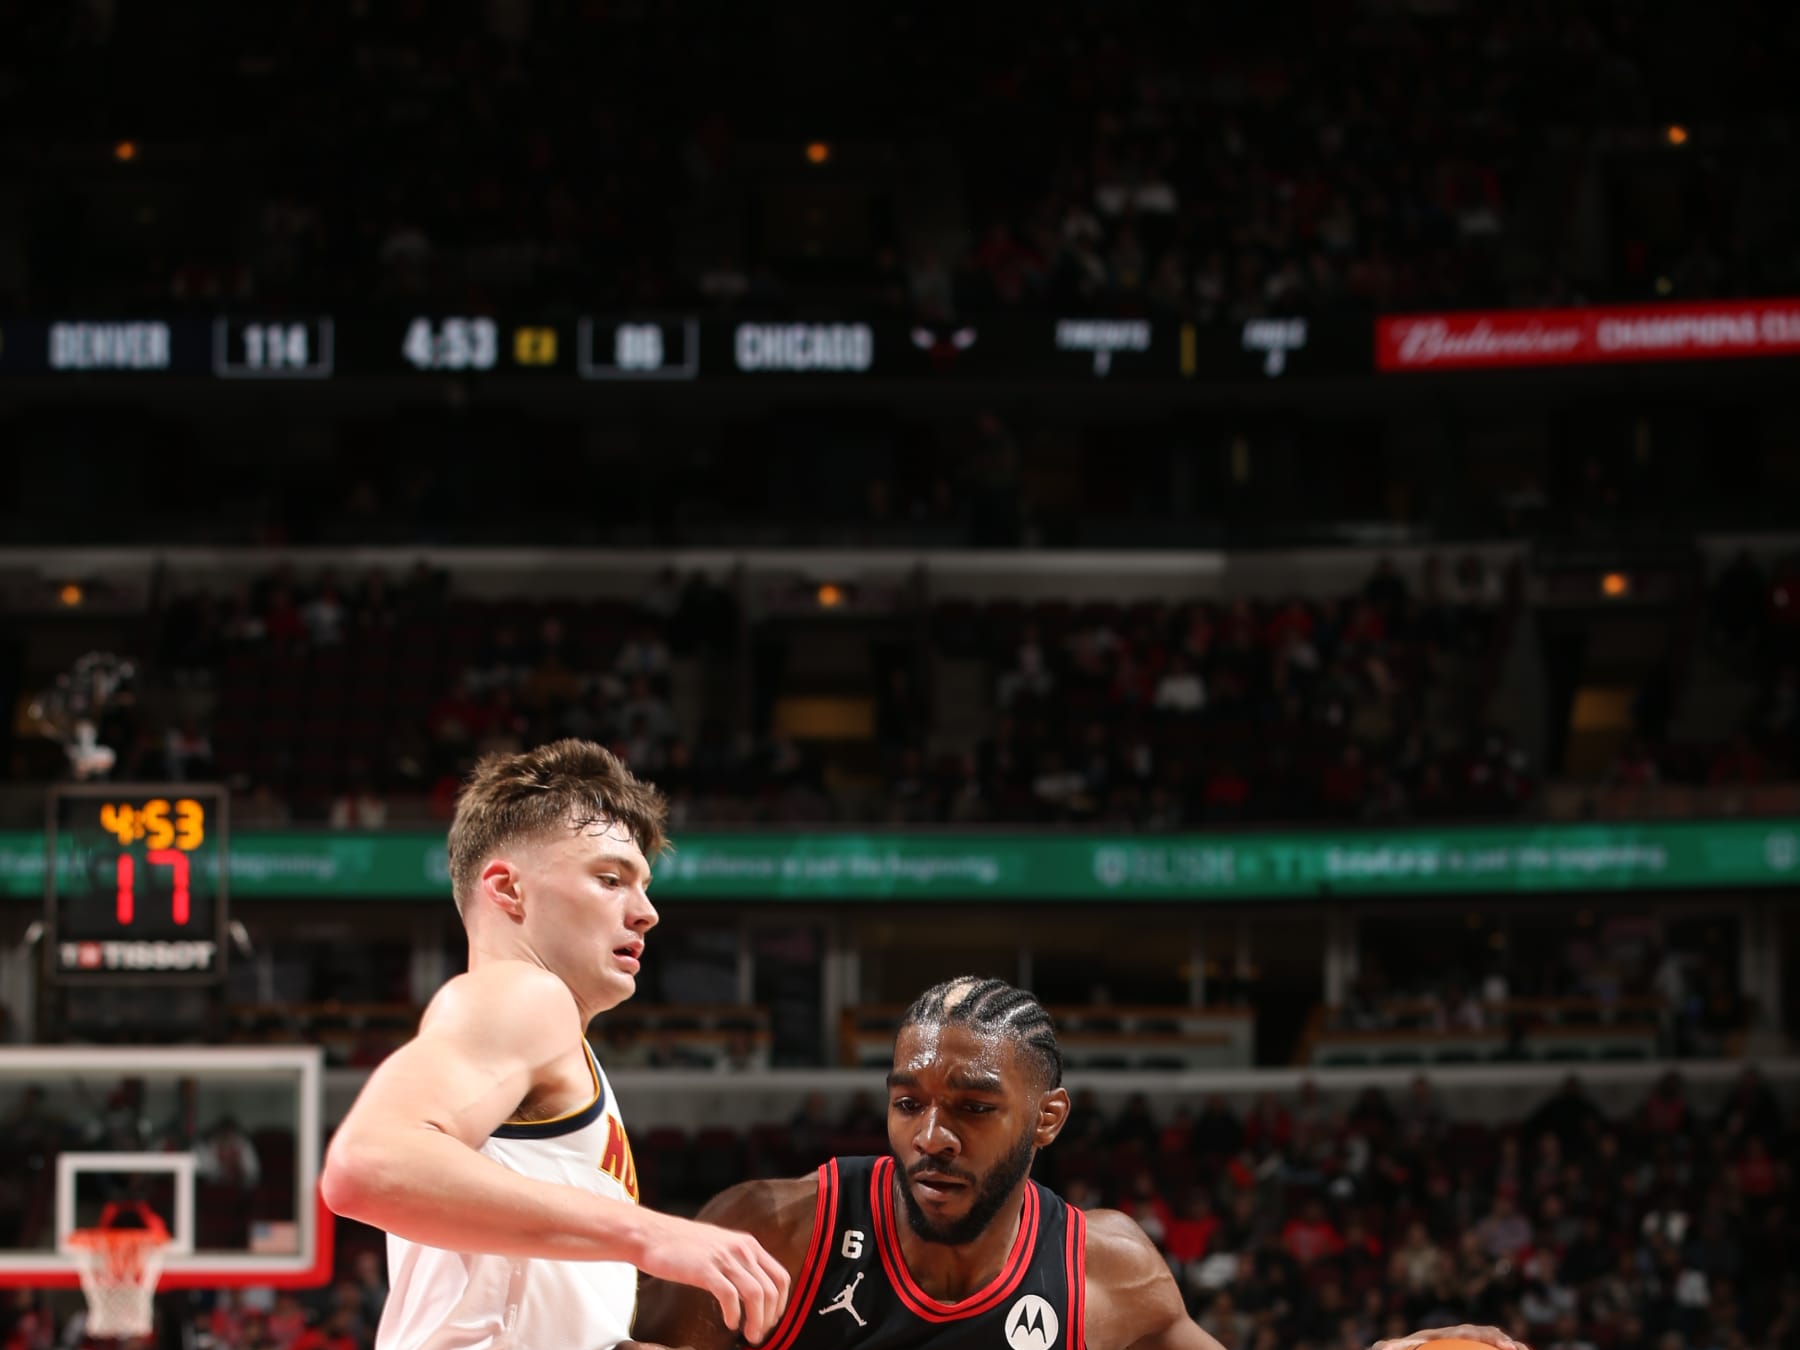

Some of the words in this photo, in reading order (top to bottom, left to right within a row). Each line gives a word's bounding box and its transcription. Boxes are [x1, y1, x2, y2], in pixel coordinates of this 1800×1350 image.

[49, 322, 171, 369] DENVER
[244, 323, 309, 369] 114
[402, 317, 499, 370] 4:53
[735, 322, 874, 371] CHICAGO
[100, 799, 204, 851] 4:53
[116, 849, 190, 926] 17
[103, 941, 216, 969] TISSOT
[841, 1229, 865, 1259] 6
